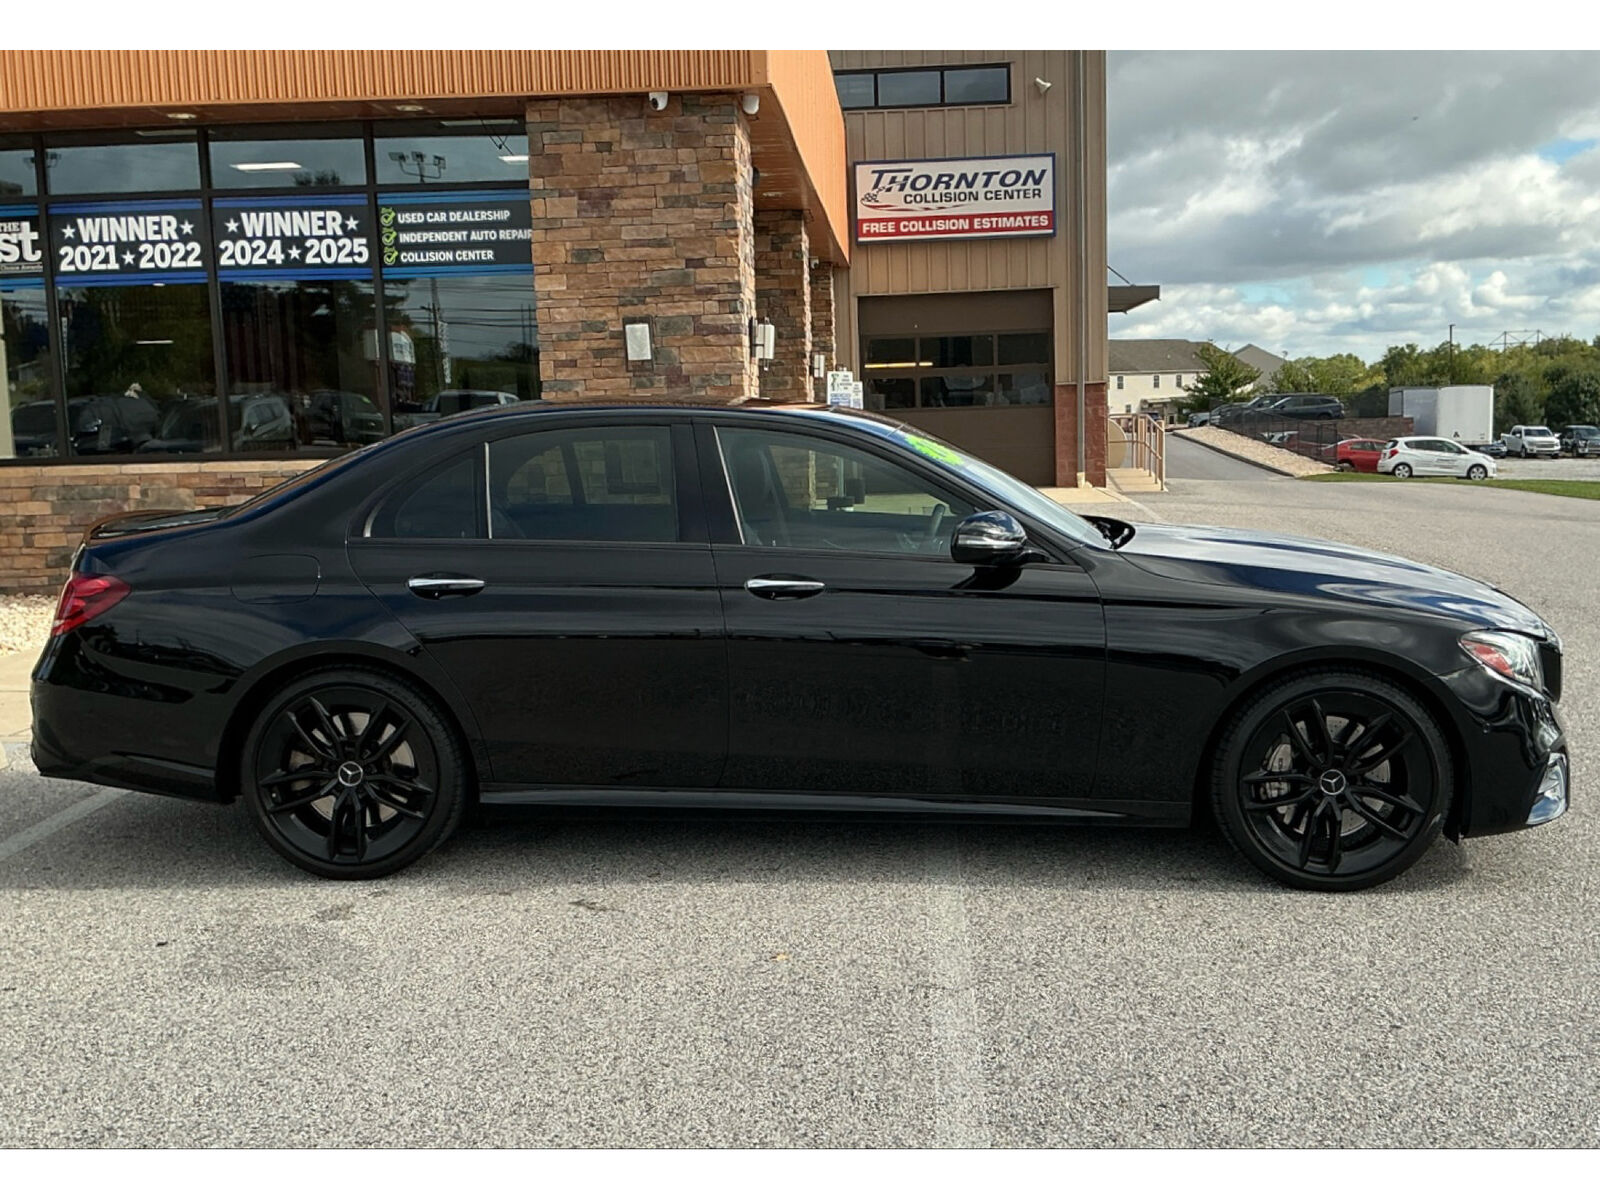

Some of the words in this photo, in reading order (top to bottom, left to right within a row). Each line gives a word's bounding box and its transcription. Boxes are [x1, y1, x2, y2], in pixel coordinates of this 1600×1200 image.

[871, 168, 1047, 193] THORNTON
[903, 190, 979, 204] COLLISION
[984, 188, 1042, 201] CENTER
[240, 210, 343, 238] WINNER
[397, 212, 425, 224] USED
[426, 211, 447, 223] CAR
[449, 209, 510, 222] DEALERSHIP
[862, 221, 896, 234] FREE
[899, 217, 969, 232] COLLISION
[973, 214, 1049, 229] ESTIMATES
[0, 221, 42, 263] st
[76, 215, 179, 244] WINNER
[399, 231, 467, 243] INDEPENDENT
[470, 230, 497, 241] AUTO
[59, 245, 120, 272] 2021
[139, 241, 203, 269] 2022
[219, 240, 285, 266] 2024
[305, 238, 369, 264] 2025
[400, 252, 453, 263] COLLISION
[455, 250, 494, 261] CENTER
